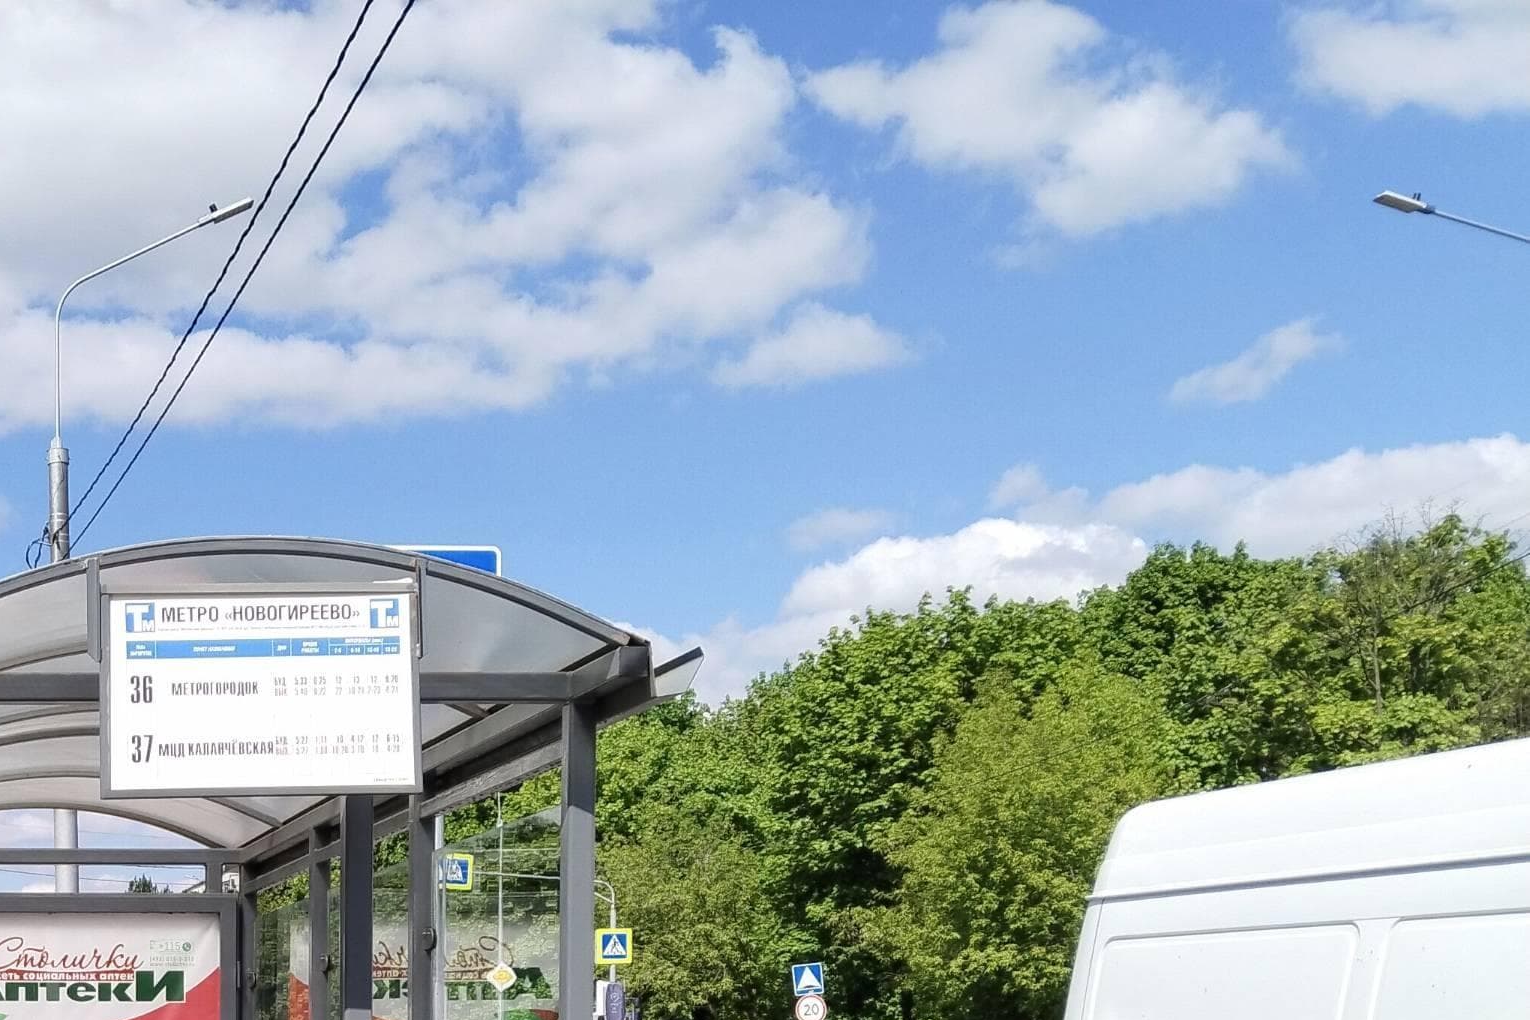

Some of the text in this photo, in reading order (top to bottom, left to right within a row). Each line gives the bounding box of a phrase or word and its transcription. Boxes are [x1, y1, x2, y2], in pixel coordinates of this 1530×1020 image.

[161, 604, 360, 622] МЕТРО «НОВОГИРЕЕВО»
[130, 675, 153, 704] 36
[171, 681, 259, 696] МЕТРОГОРОДОК
[131, 735, 153, 763] 37
[158, 743, 185, 758] МЦД
[188, 739, 274, 756] КАЛАНЧЁВСКАЯ
[23, 972, 97, 982] социальных
[804, 1003, 820, 1016] 20
